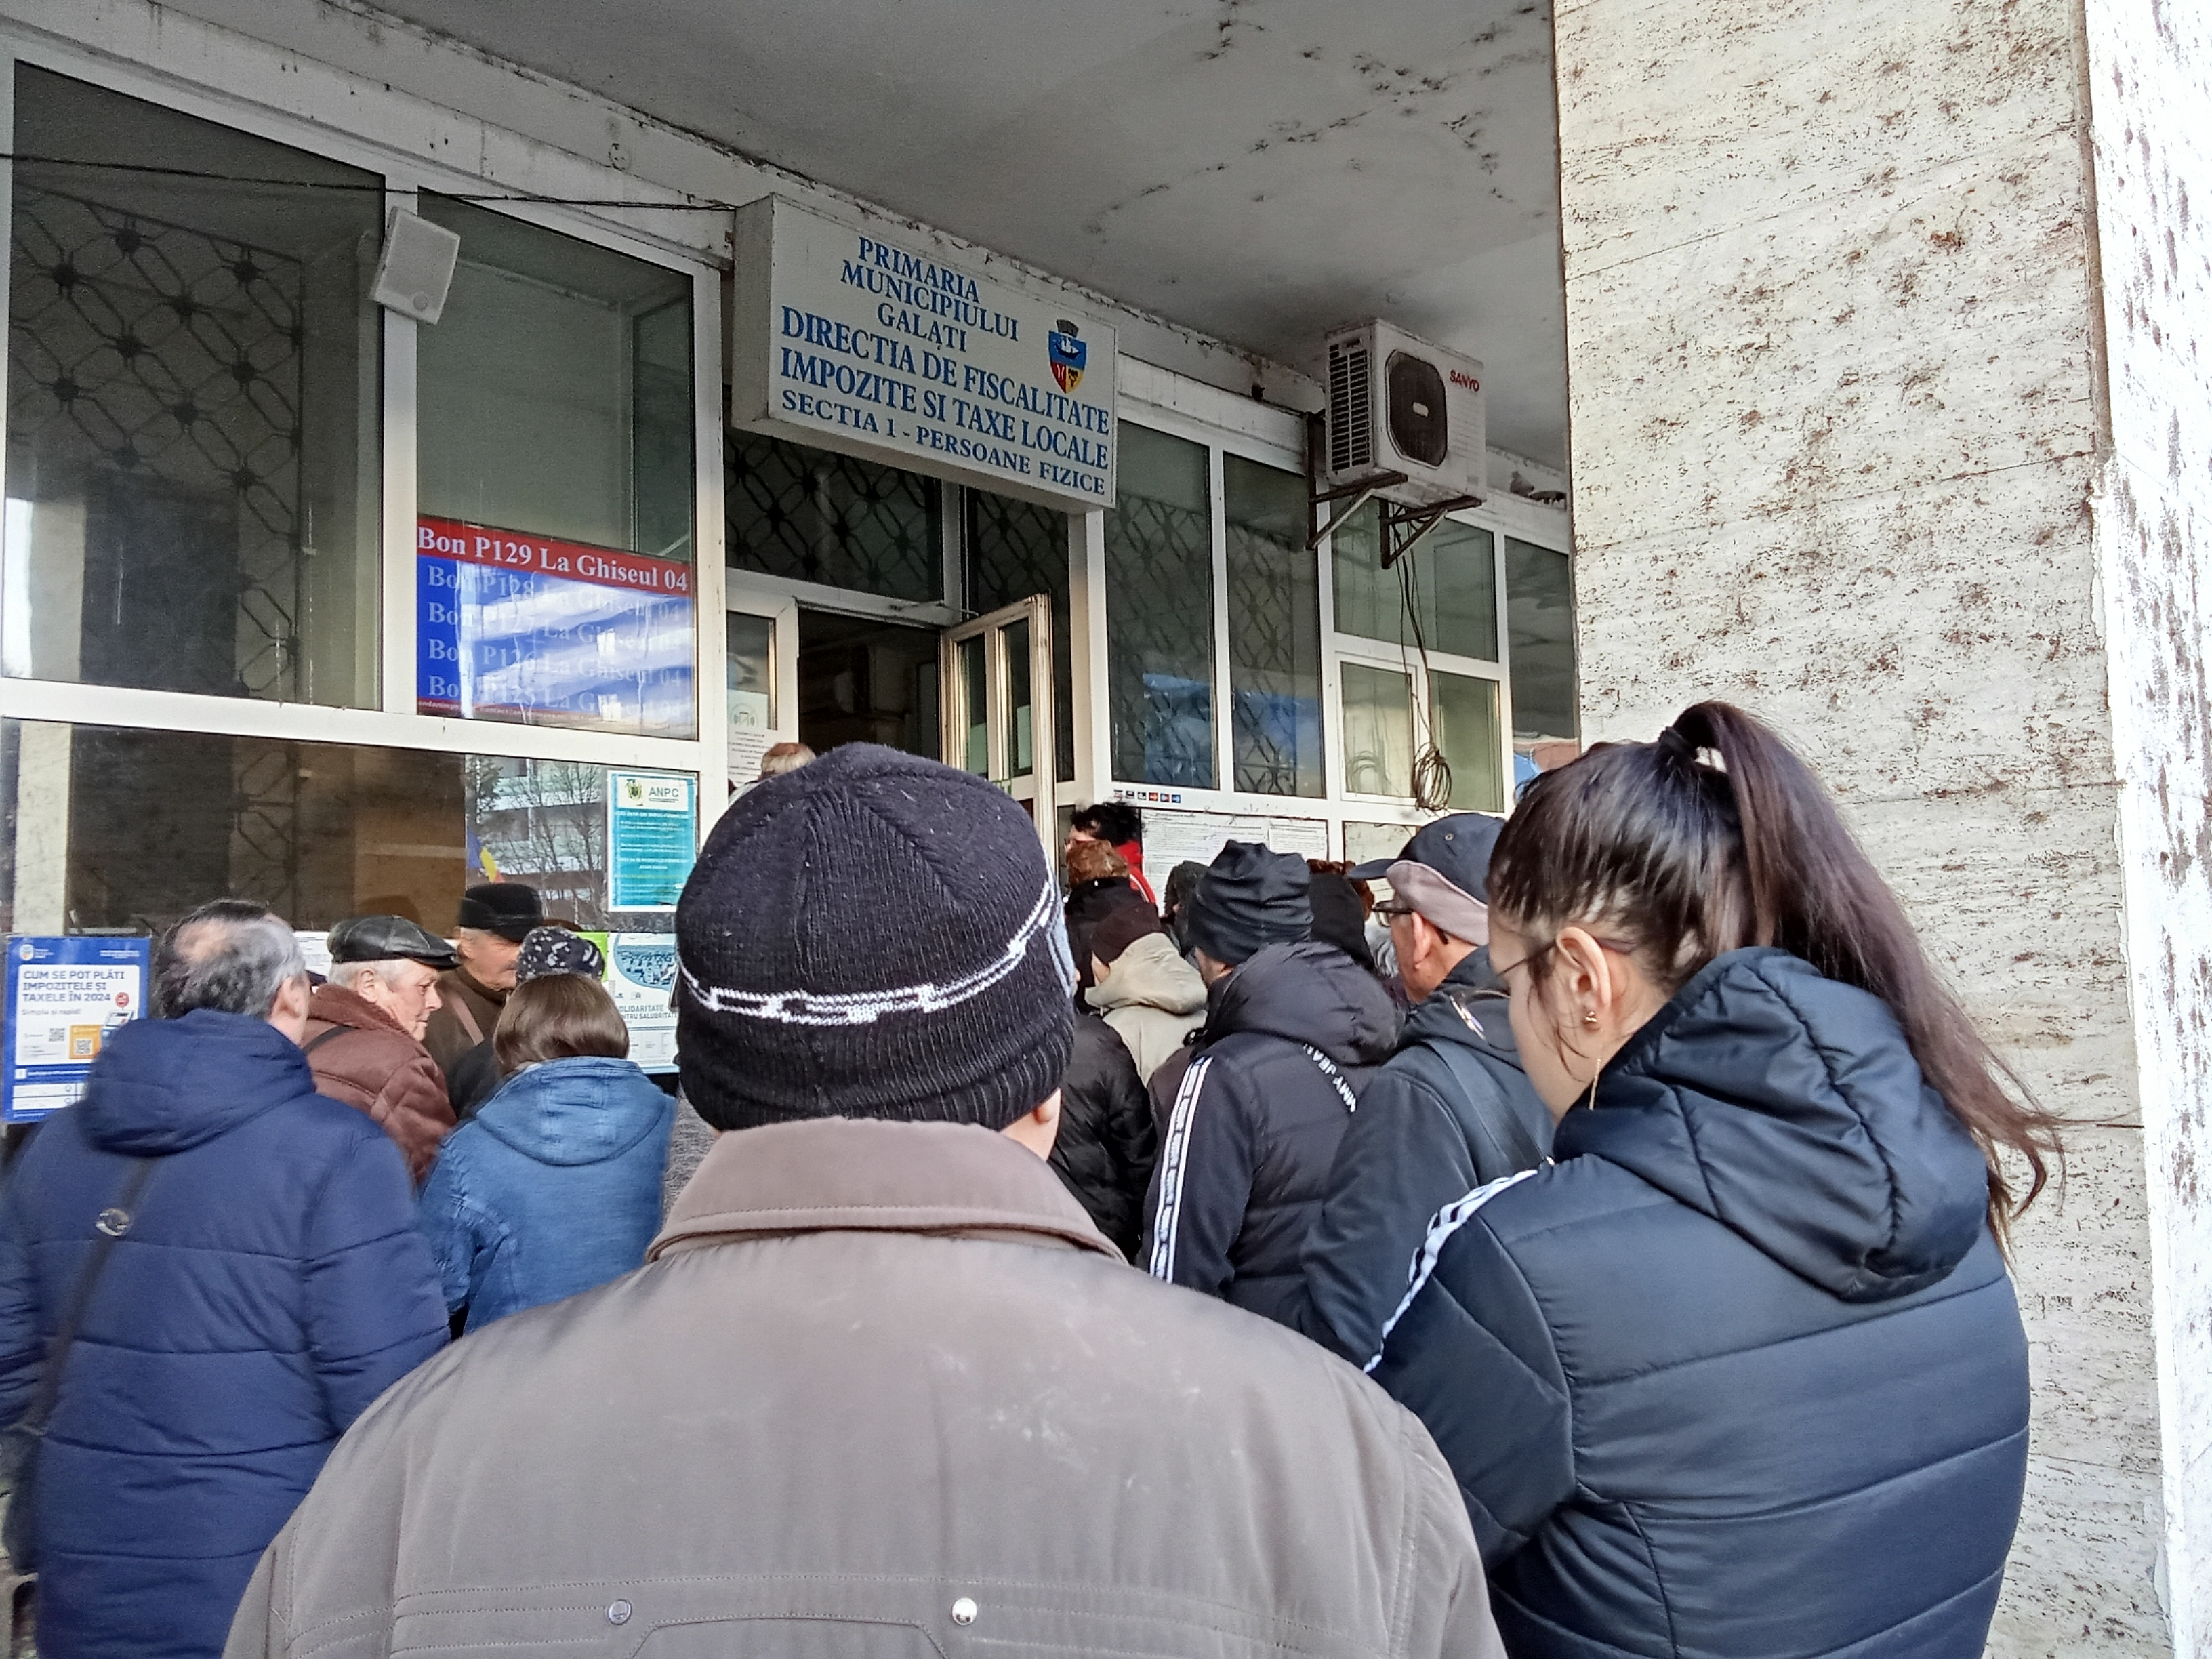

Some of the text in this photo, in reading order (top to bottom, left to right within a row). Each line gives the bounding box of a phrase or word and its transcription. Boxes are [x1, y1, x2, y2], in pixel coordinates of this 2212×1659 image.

[859, 237, 980, 304] PRIMARIA
[840, 260, 1019, 342] MUNICIPIULUI
[781, 306, 1109, 436] DIRECTIA DE FISCALITATE
[1450, 369, 1479, 392] SANYO
[781, 346, 1108, 470] IMPOZITE SI TAXE LOCALE
[782, 390, 879, 434] SECTIA
[916, 425, 1030, 474] PERSOANE
[1039, 460, 1105, 495] FIZICE
[417, 527, 687, 591] Bon P129 La Ghiseul 04
[649, 787, 679, 797] ANPC
[22, 982, 93, 991] IMPOZITELE
[23, 970, 125, 979] CUM SE POT PLĂTI
[22, 993, 66, 1002] TAXELE
[84, 993, 111, 1001] 2024
[619, 1004, 664, 1012] OLIDARITATE
